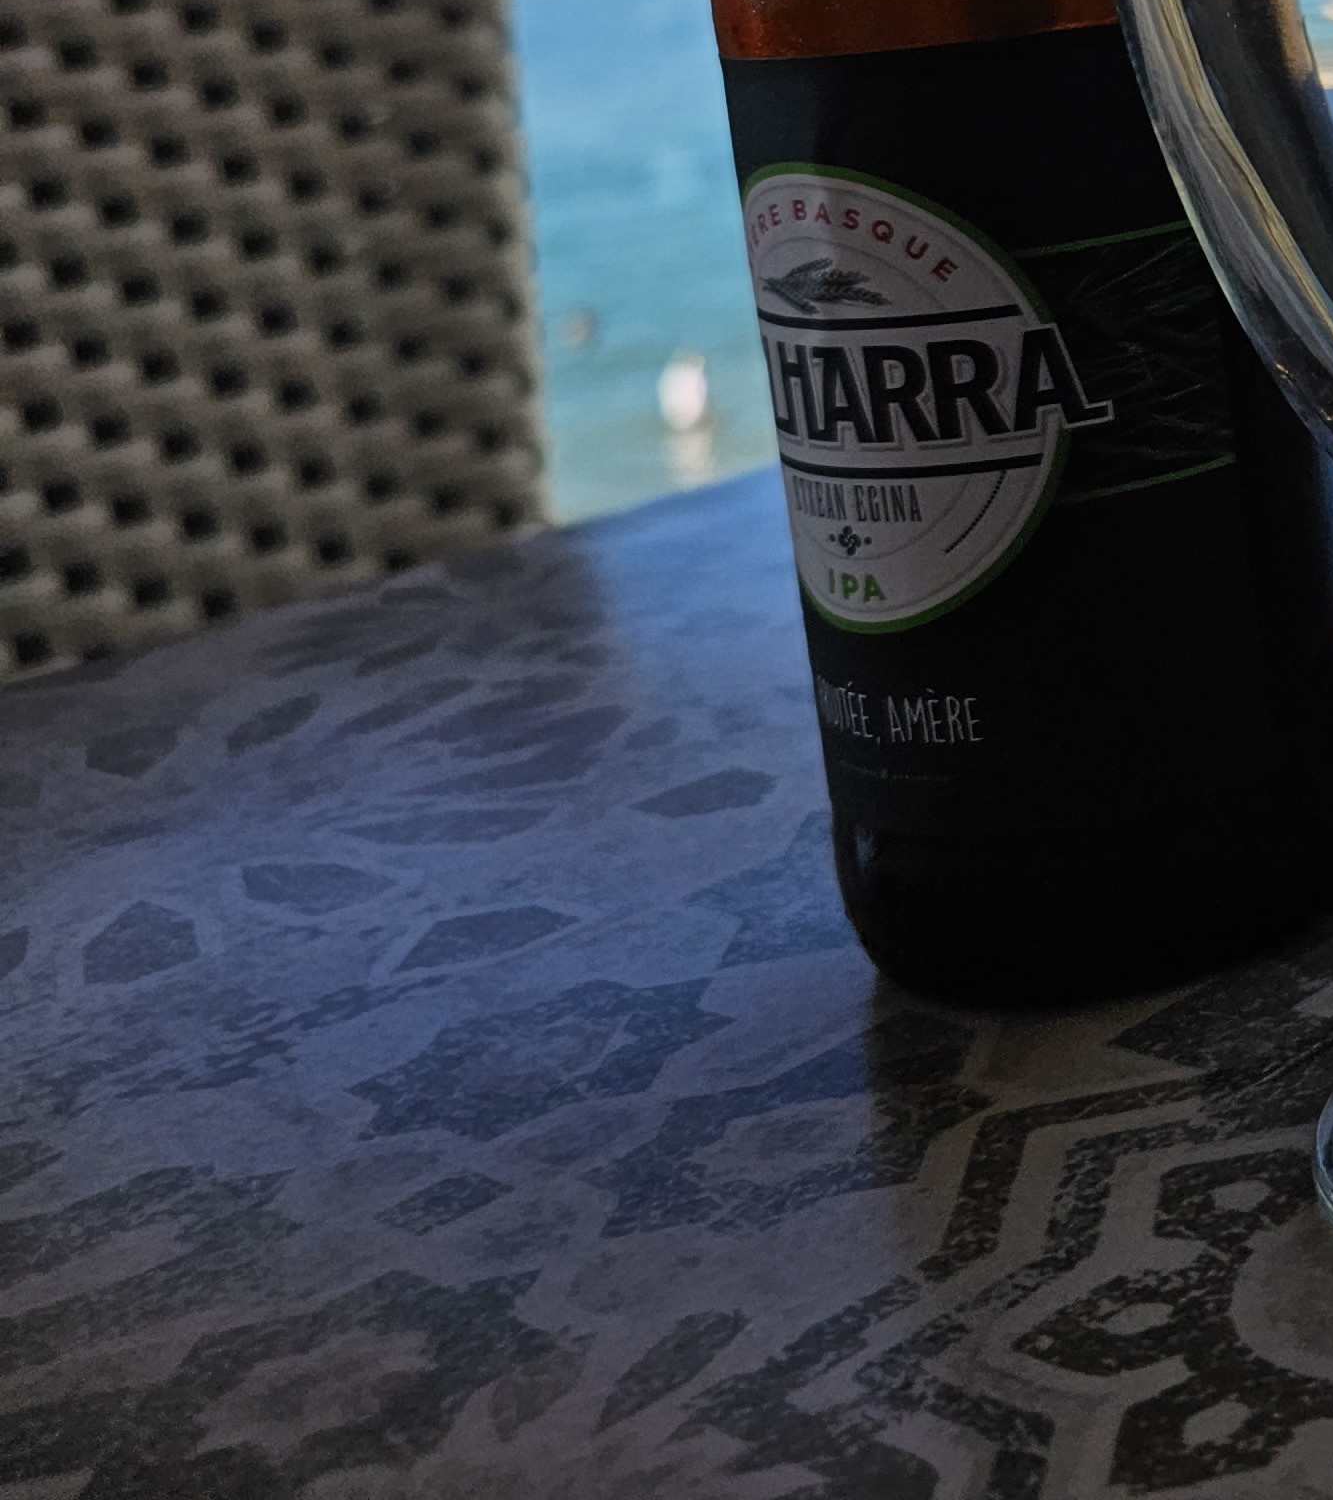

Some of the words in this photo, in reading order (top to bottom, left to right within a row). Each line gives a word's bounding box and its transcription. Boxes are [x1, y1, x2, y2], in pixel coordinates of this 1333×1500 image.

[791, 199, 960, 283] BASQUE
[828, 566, 888, 603] IPA
[886, 687, 985, 745] AMÈRE
